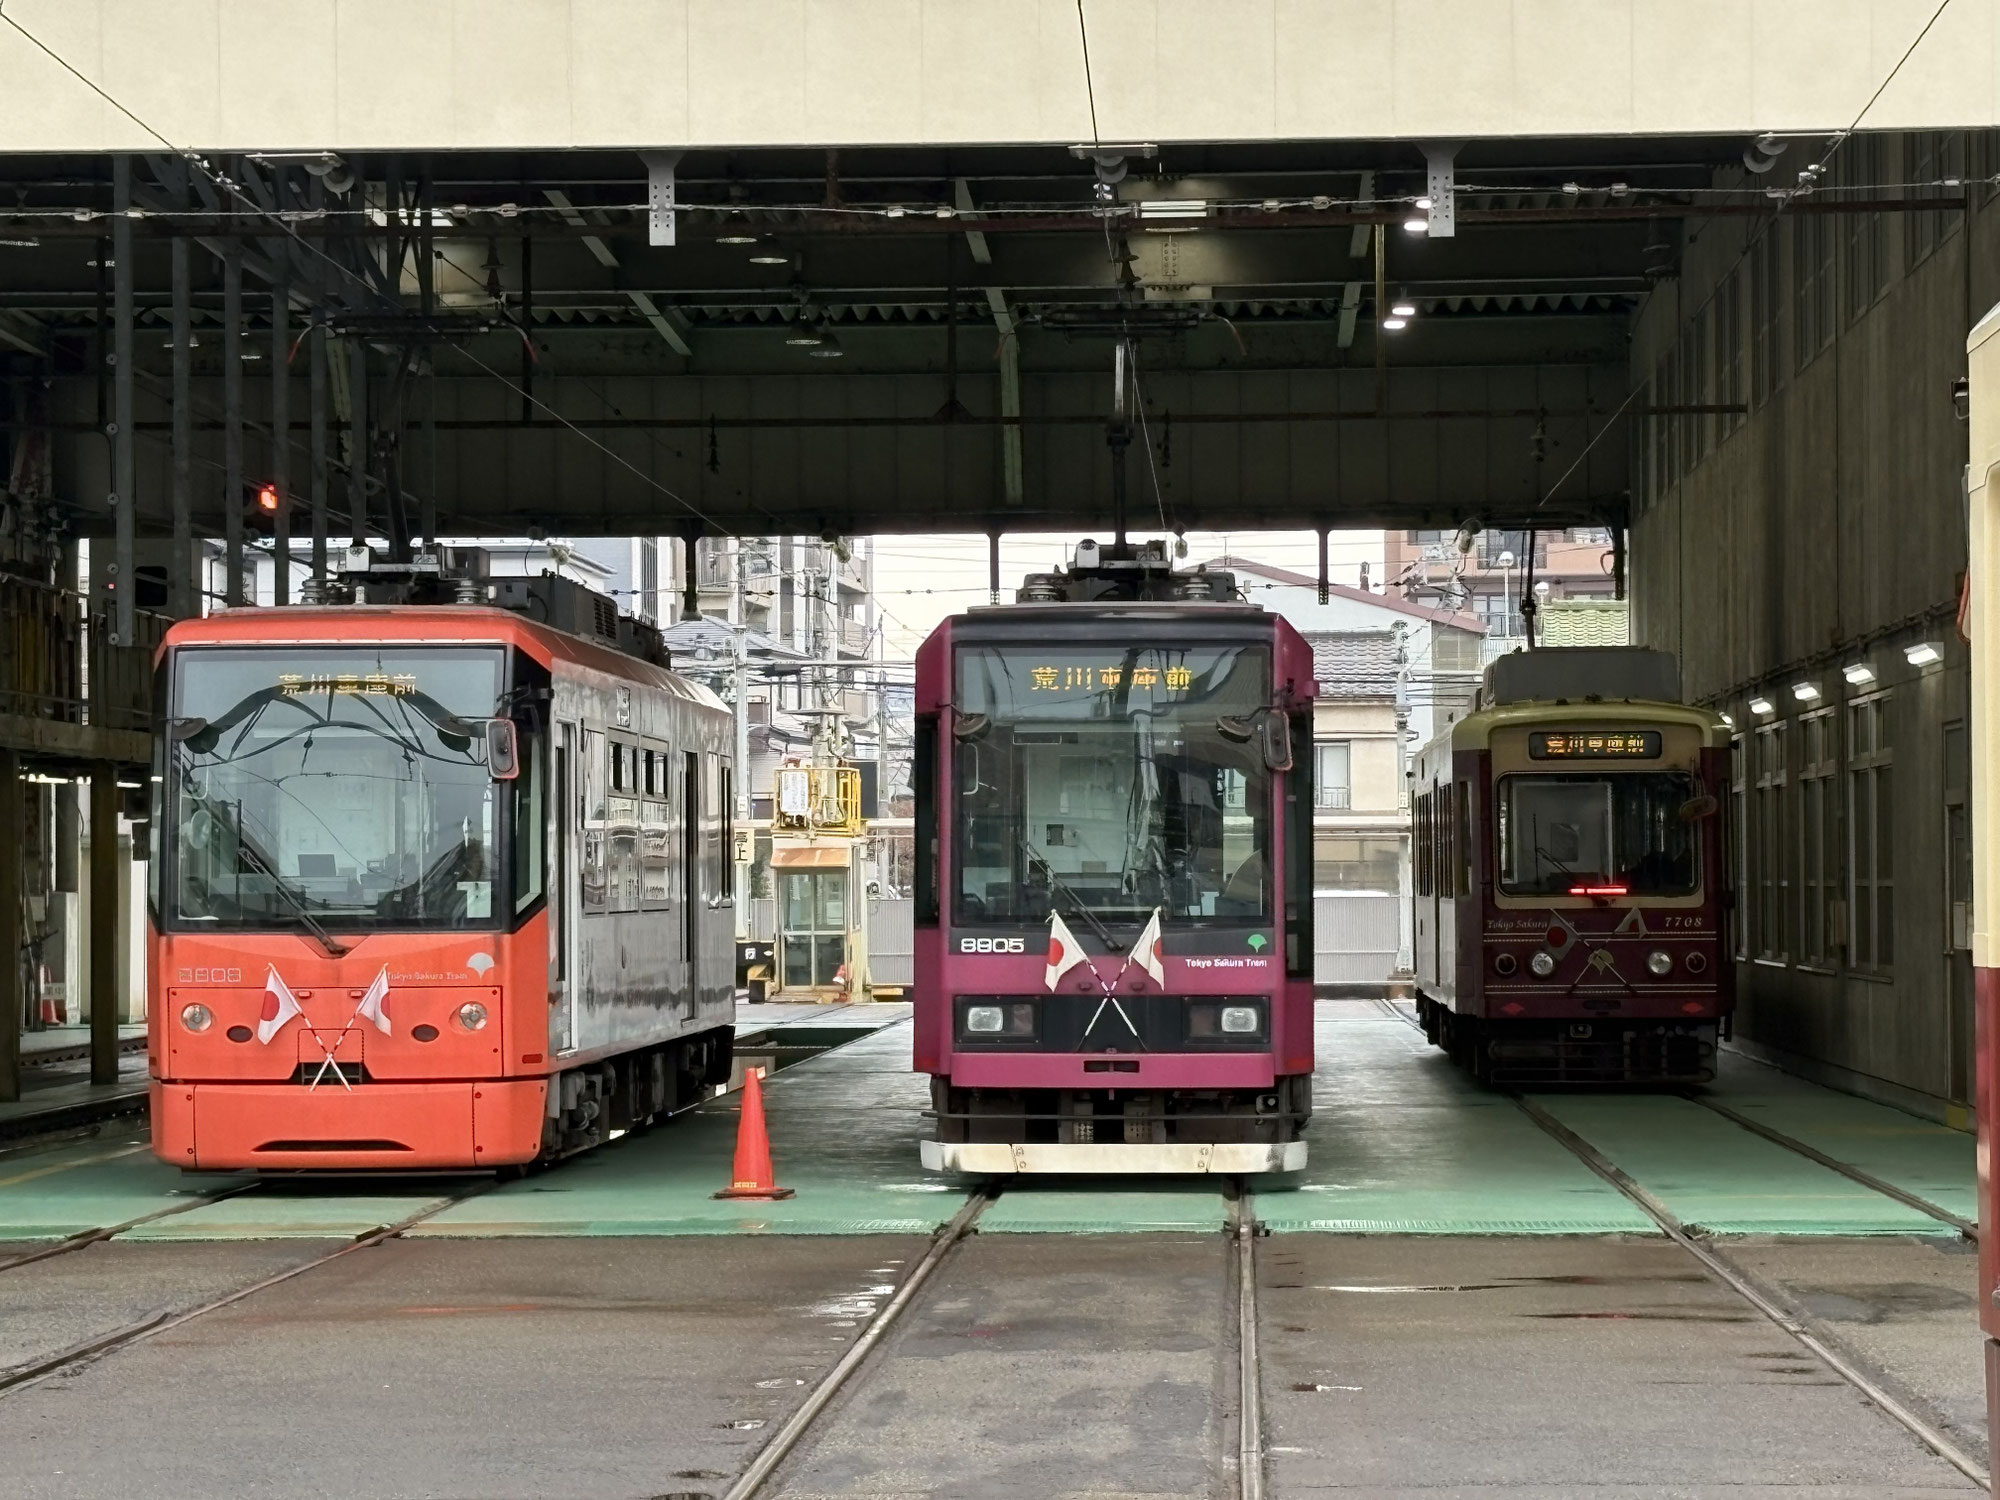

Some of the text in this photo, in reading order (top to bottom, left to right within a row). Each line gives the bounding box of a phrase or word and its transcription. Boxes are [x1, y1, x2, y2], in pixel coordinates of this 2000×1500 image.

[1487, 918, 1548, 930] Tokyo Sakura
[1664, 916, 1703, 928] 7708
[960, 937, 1025, 953] 8905
[1185, 958, 1268, 969] Tokyo Sakura Tram
